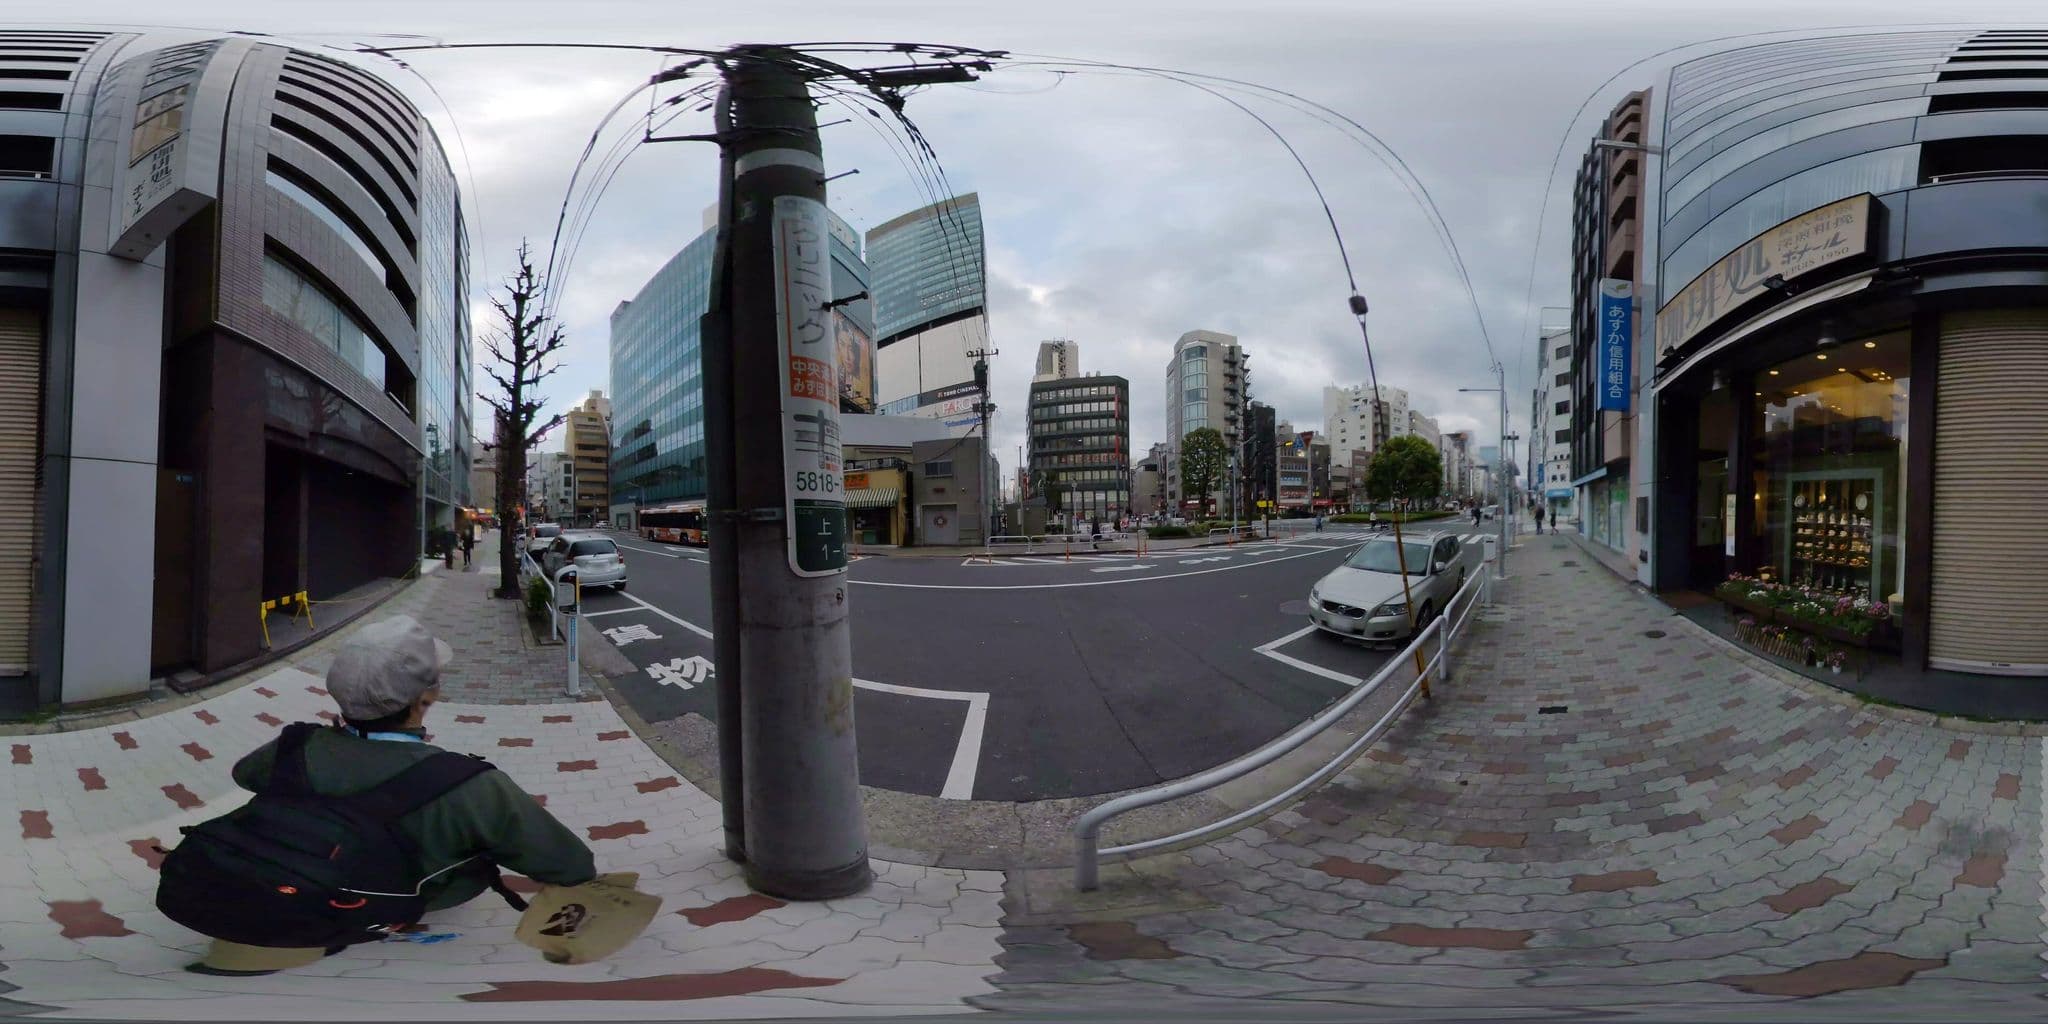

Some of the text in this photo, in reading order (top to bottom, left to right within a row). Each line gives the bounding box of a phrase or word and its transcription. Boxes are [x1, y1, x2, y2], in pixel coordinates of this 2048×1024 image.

[1781, 230, 1849, 265] ボナール
[1820, 246, 1850, 263] 1950
[1608, 305, 1625, 398] あすか信用組合
[796, 471, 843, 493] 5818-
